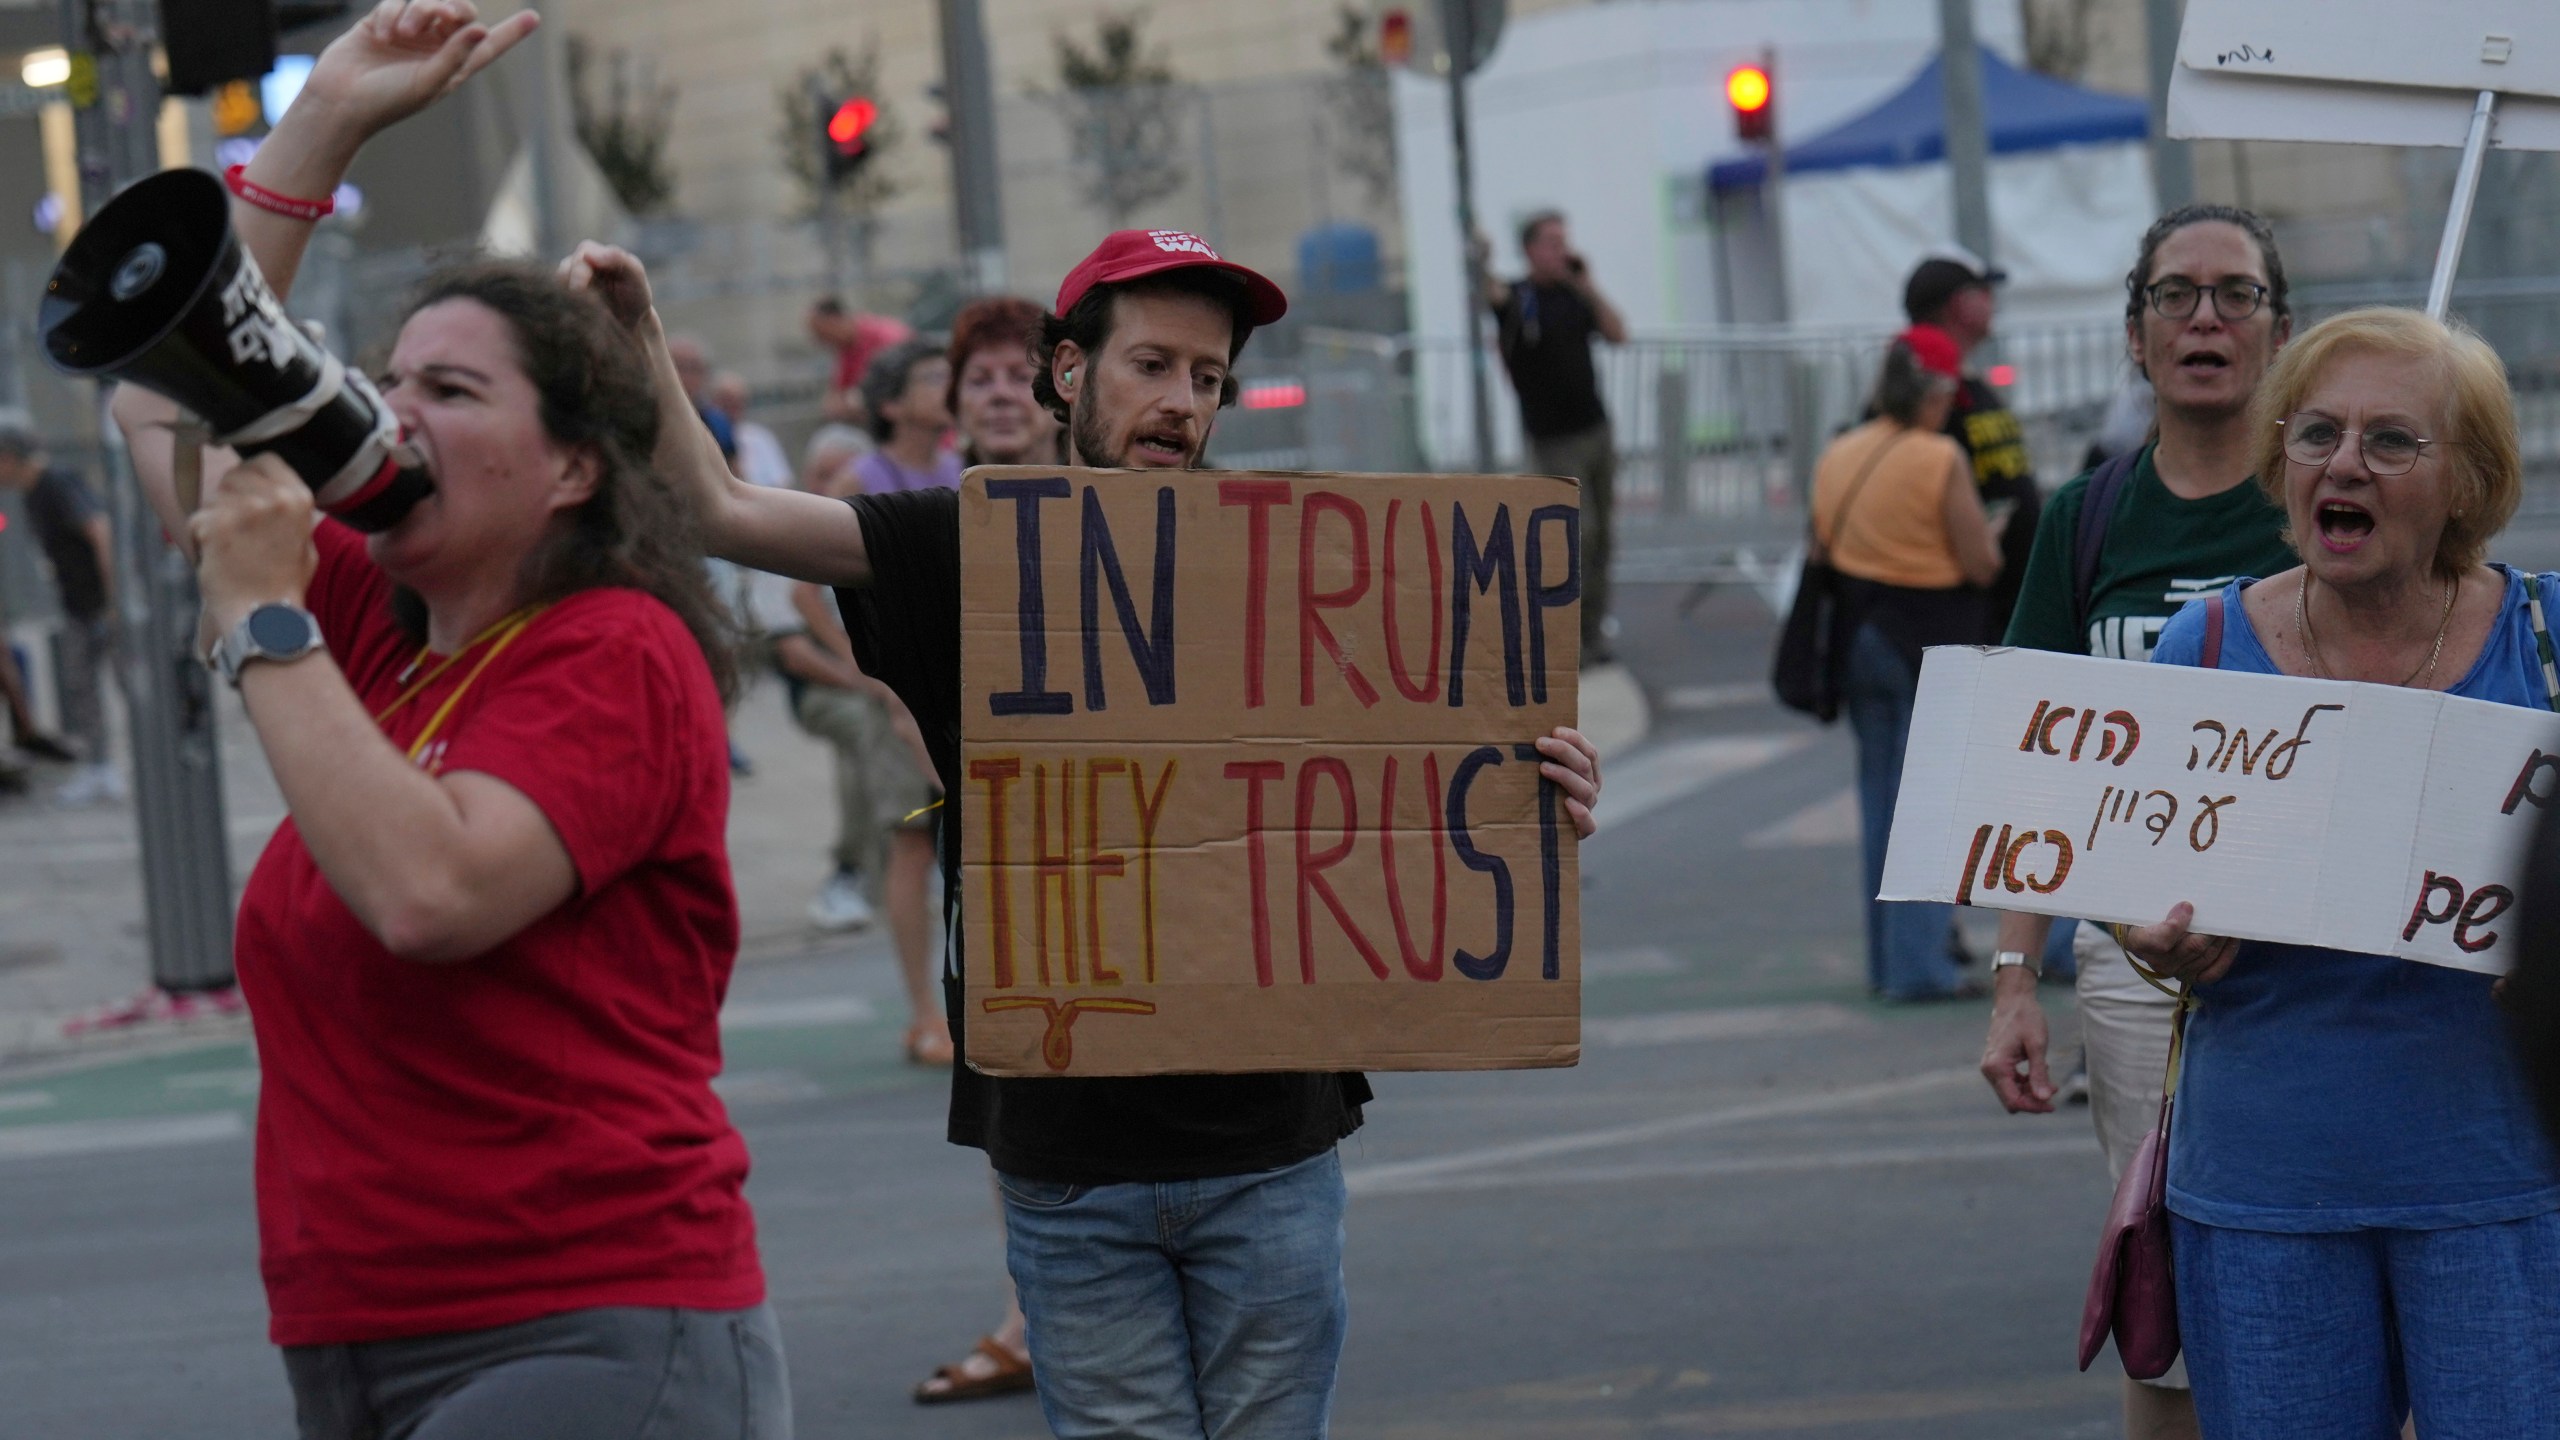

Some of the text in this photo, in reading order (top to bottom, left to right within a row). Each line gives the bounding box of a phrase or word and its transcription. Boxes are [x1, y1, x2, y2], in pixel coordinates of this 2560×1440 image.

[985, 476, 1581, 715] IN TRUMP
[2019, 700, 2345, 780] למה הוא
[2086, 785, 2236, 853] עדיין
[969, 744, 1561, 990] THEY TRUST
[1956, 823, 2073, 906] כאן
